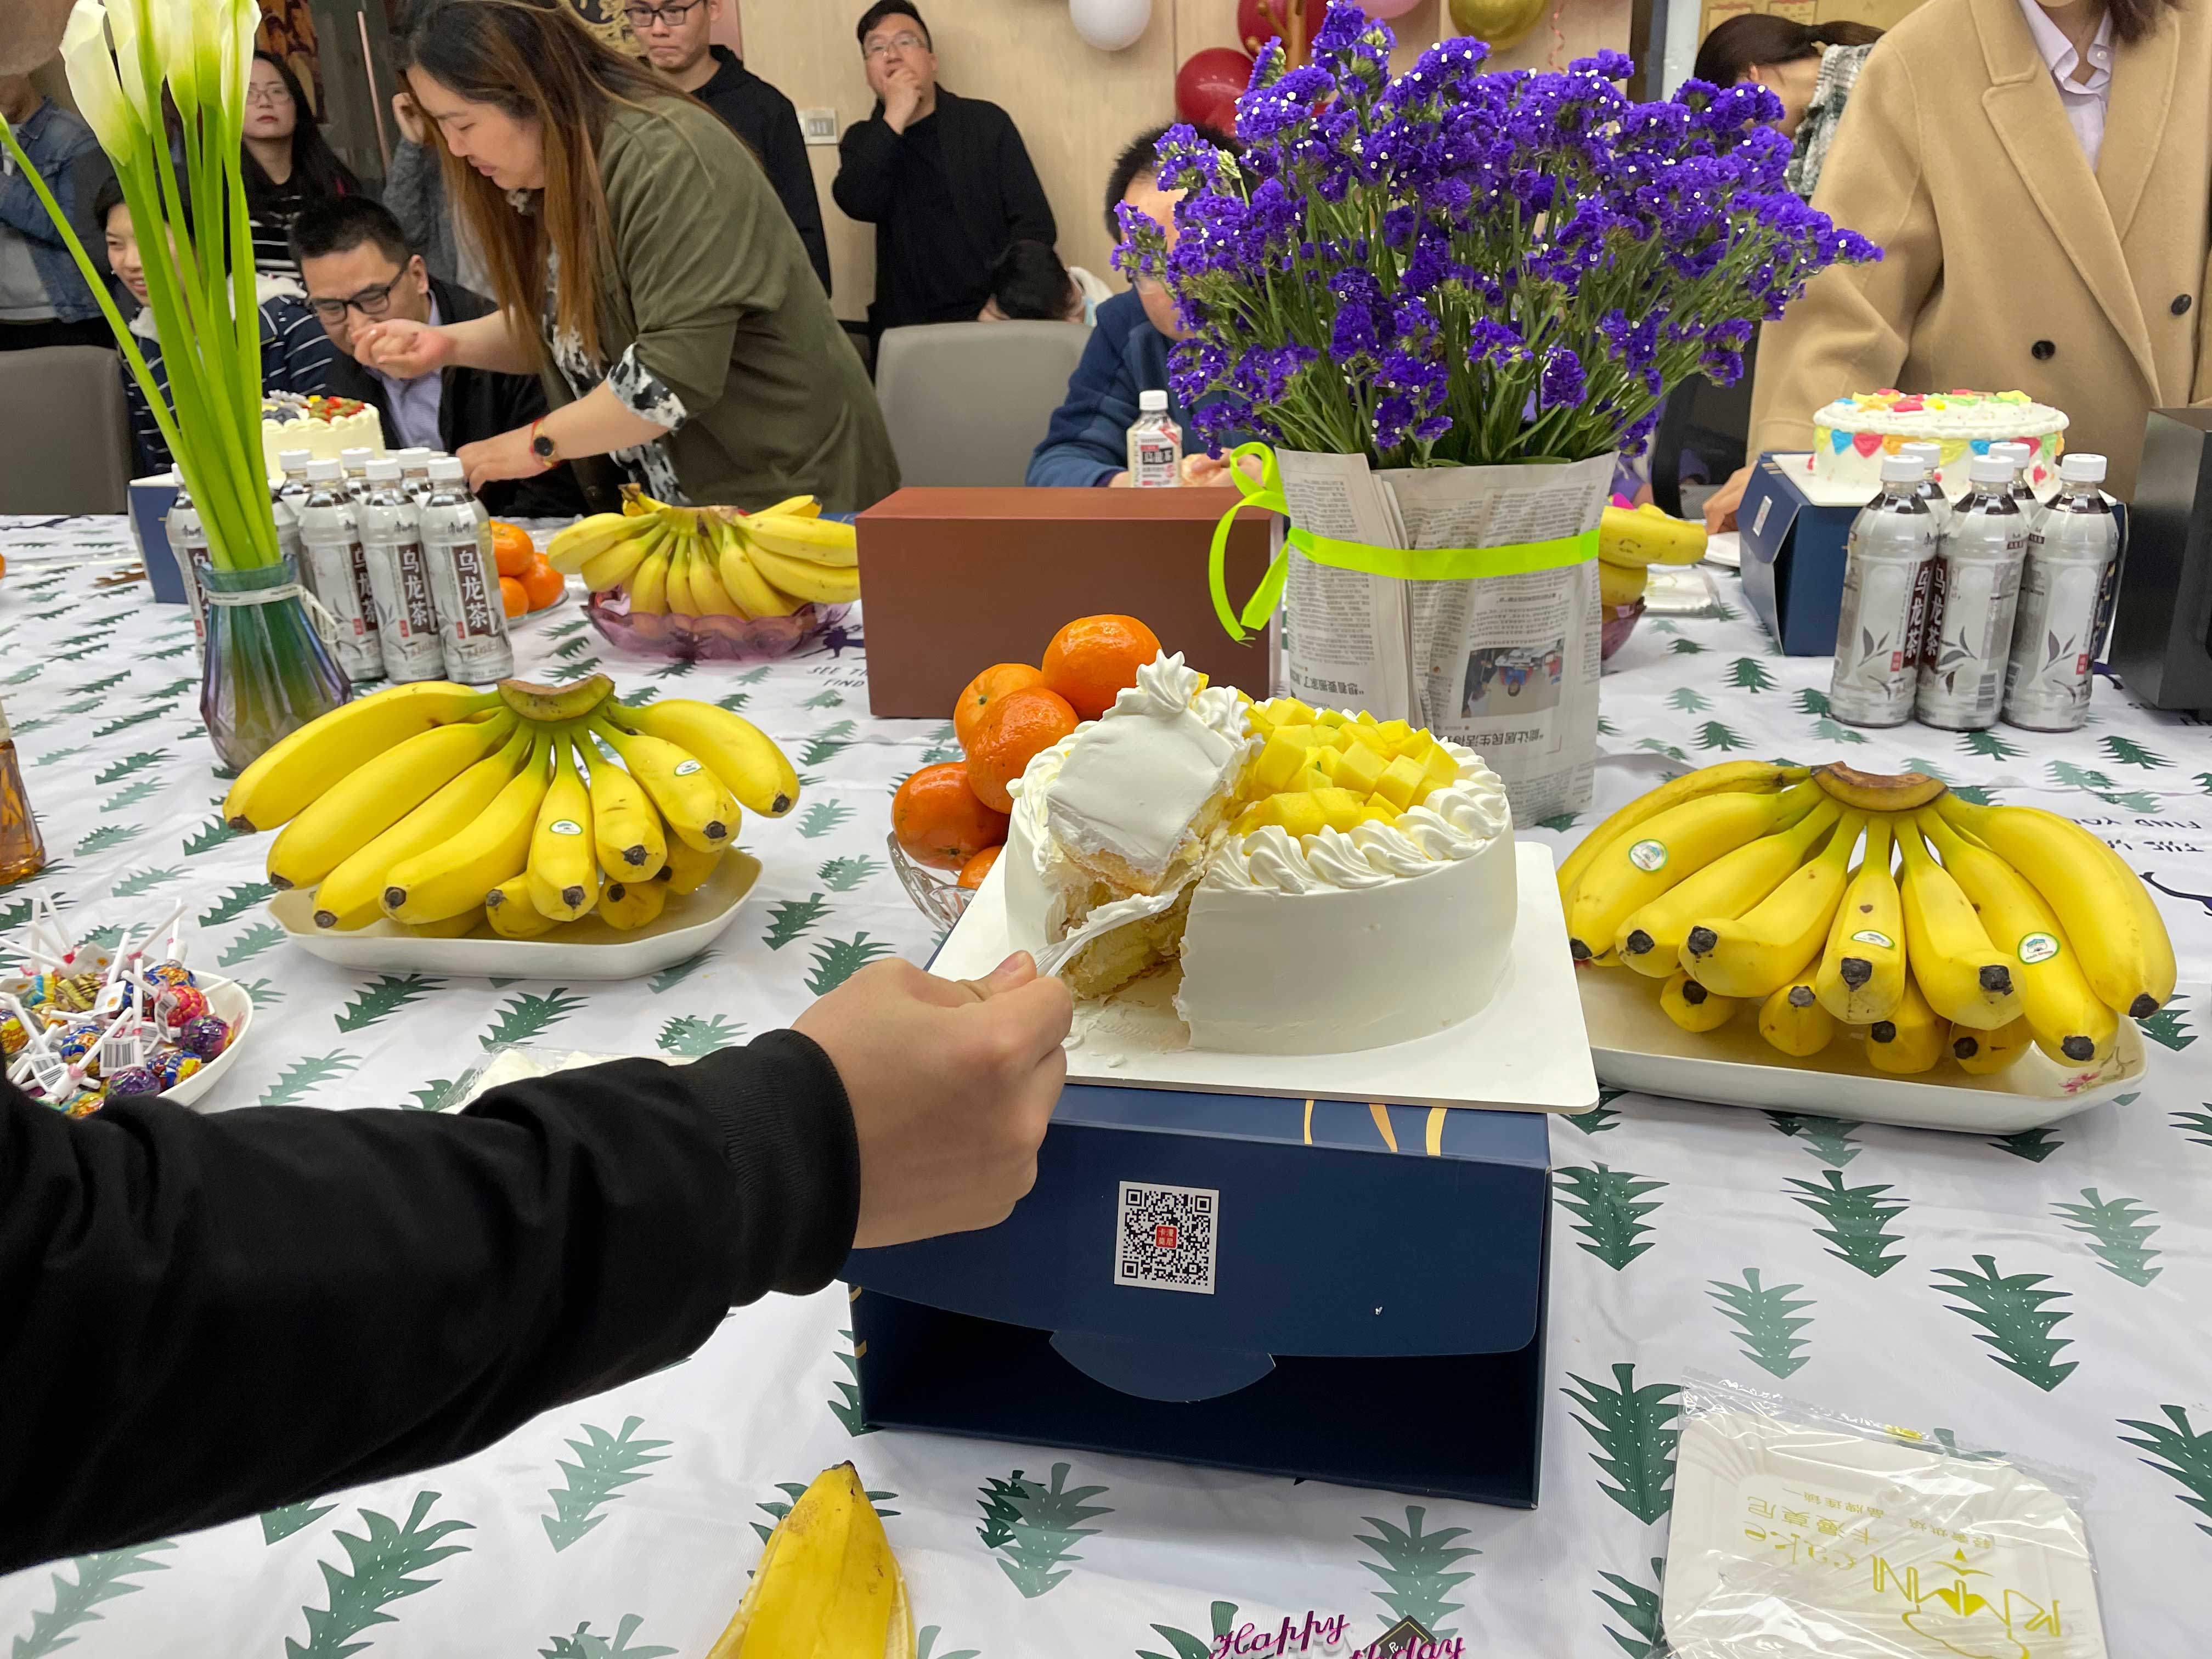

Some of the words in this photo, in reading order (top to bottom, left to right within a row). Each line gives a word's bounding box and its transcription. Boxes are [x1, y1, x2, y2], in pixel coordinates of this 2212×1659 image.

[402, 549, 427, 627] 乌龙茶
[458, 550, 487, 628] 乌龙茶
[1906, 566, 1928, 659] 乌龙茶
[1925, 563, 1945, 657] 乌龙茶
[823, 679, 865, 687] FIND
[2135, 818, 2202, 830] FIND
[1742, 1520, 1858, 1572] cake
[1747, 1496, 1880, 1546] 卡漫莫尼
[1209, 1610, 1350, 1659] Happy
